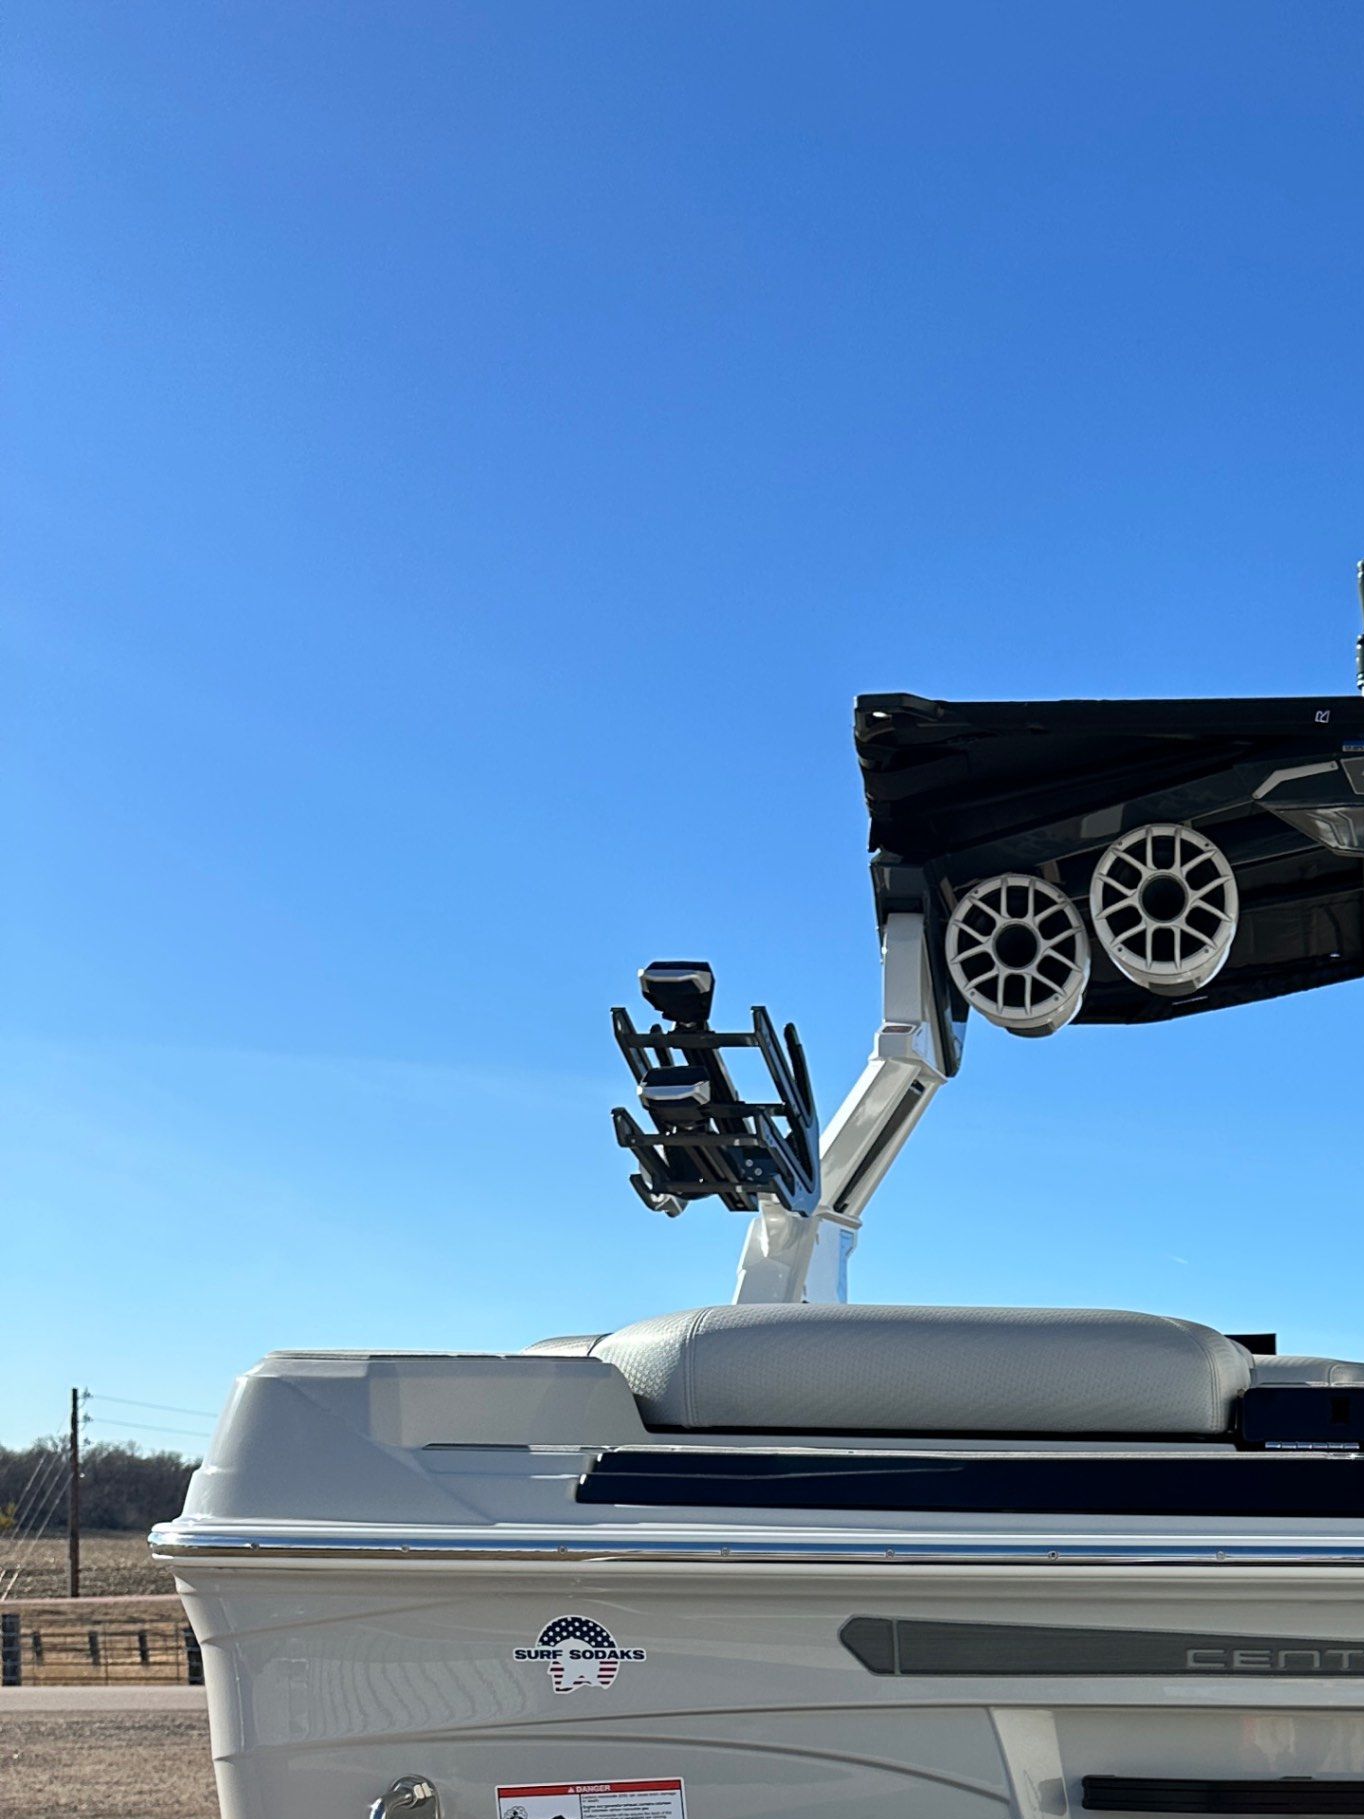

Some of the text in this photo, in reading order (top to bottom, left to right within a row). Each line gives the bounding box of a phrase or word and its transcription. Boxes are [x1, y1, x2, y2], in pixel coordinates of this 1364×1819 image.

[514, 1649, 645, 1660] SURF SODAKS
[576, 1784, 611, 1794] DANGER
